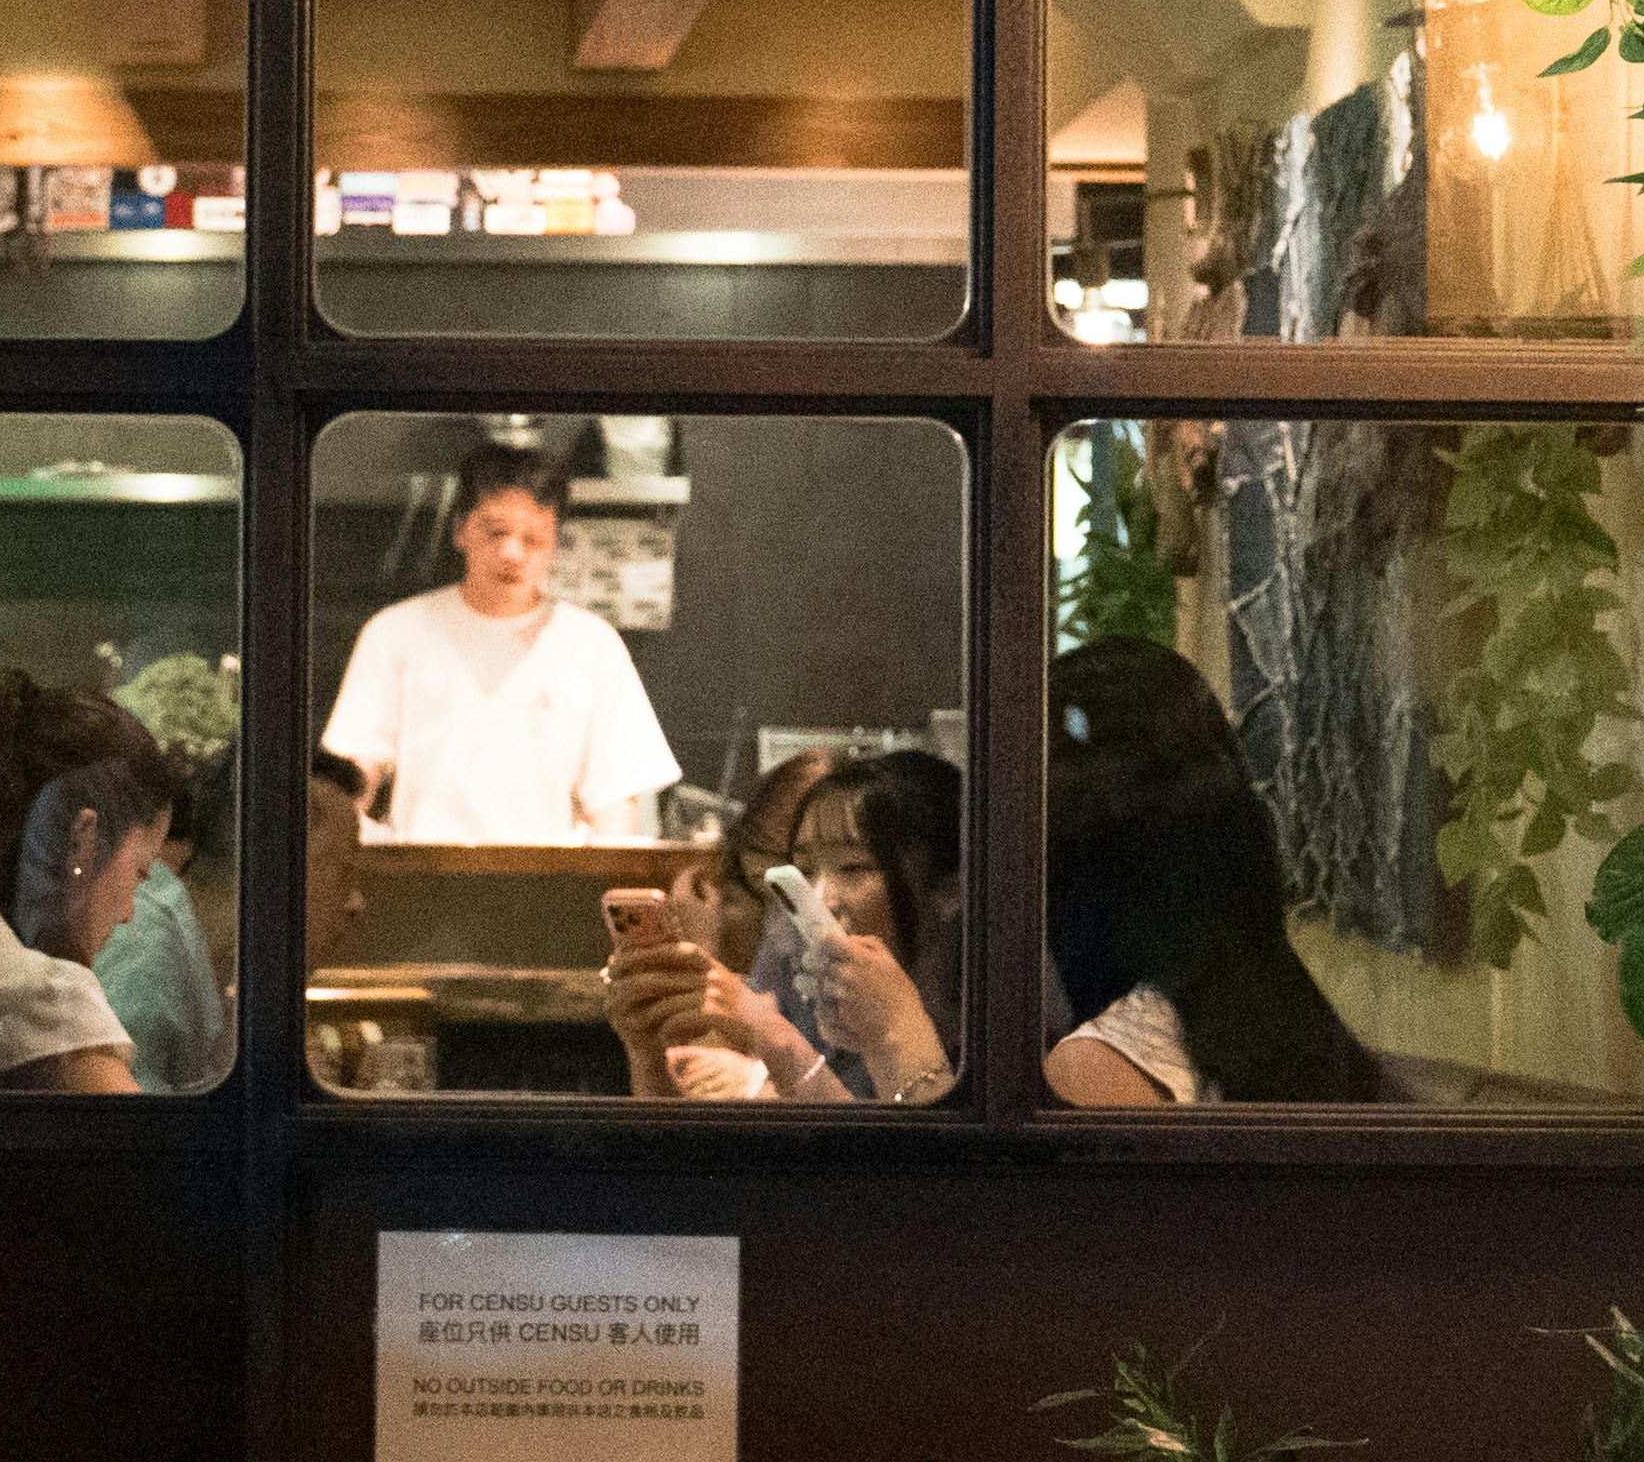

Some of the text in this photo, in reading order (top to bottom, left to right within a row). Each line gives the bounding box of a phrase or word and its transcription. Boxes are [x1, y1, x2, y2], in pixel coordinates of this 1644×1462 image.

[419, 1293, 700, 1314] FOR CENSU GUESTS ONLY
[418, 1319, 700, 1347] 座位只供 CENSU 客人使用
[413, 1377, 704, 1398] NO OUTSIDE FOOD OR DRINKS
